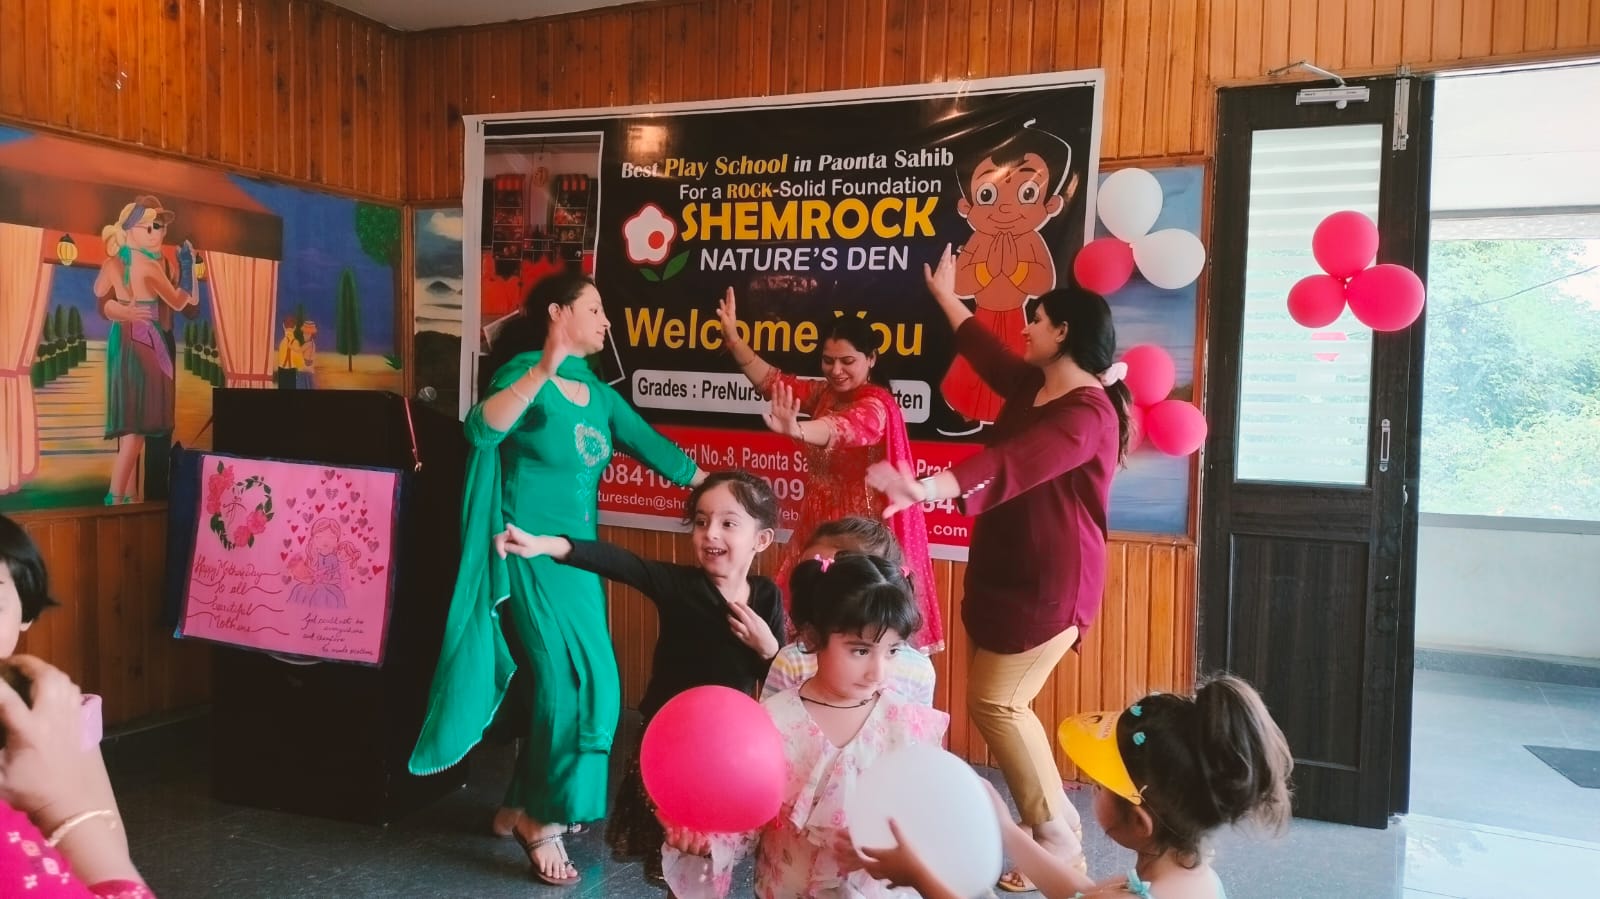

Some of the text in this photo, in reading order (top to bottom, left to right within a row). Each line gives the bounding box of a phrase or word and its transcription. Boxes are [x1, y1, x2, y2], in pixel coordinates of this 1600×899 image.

[621, 147, 954, 181] Best Play School in Paonta Sahib
[679, 176, 942, 200] For a ROCK-Solid Foundation
[681, 196, 939, 242] SHEMROCK
[700, 245, 909, 272] NATURE'S DEN
[833, 310, 923, 357] ou
[637, 376, 688, 399] Grades
[701, 379, 773, 402] PreNurs
[742, 446, 789, 472] Paonta
